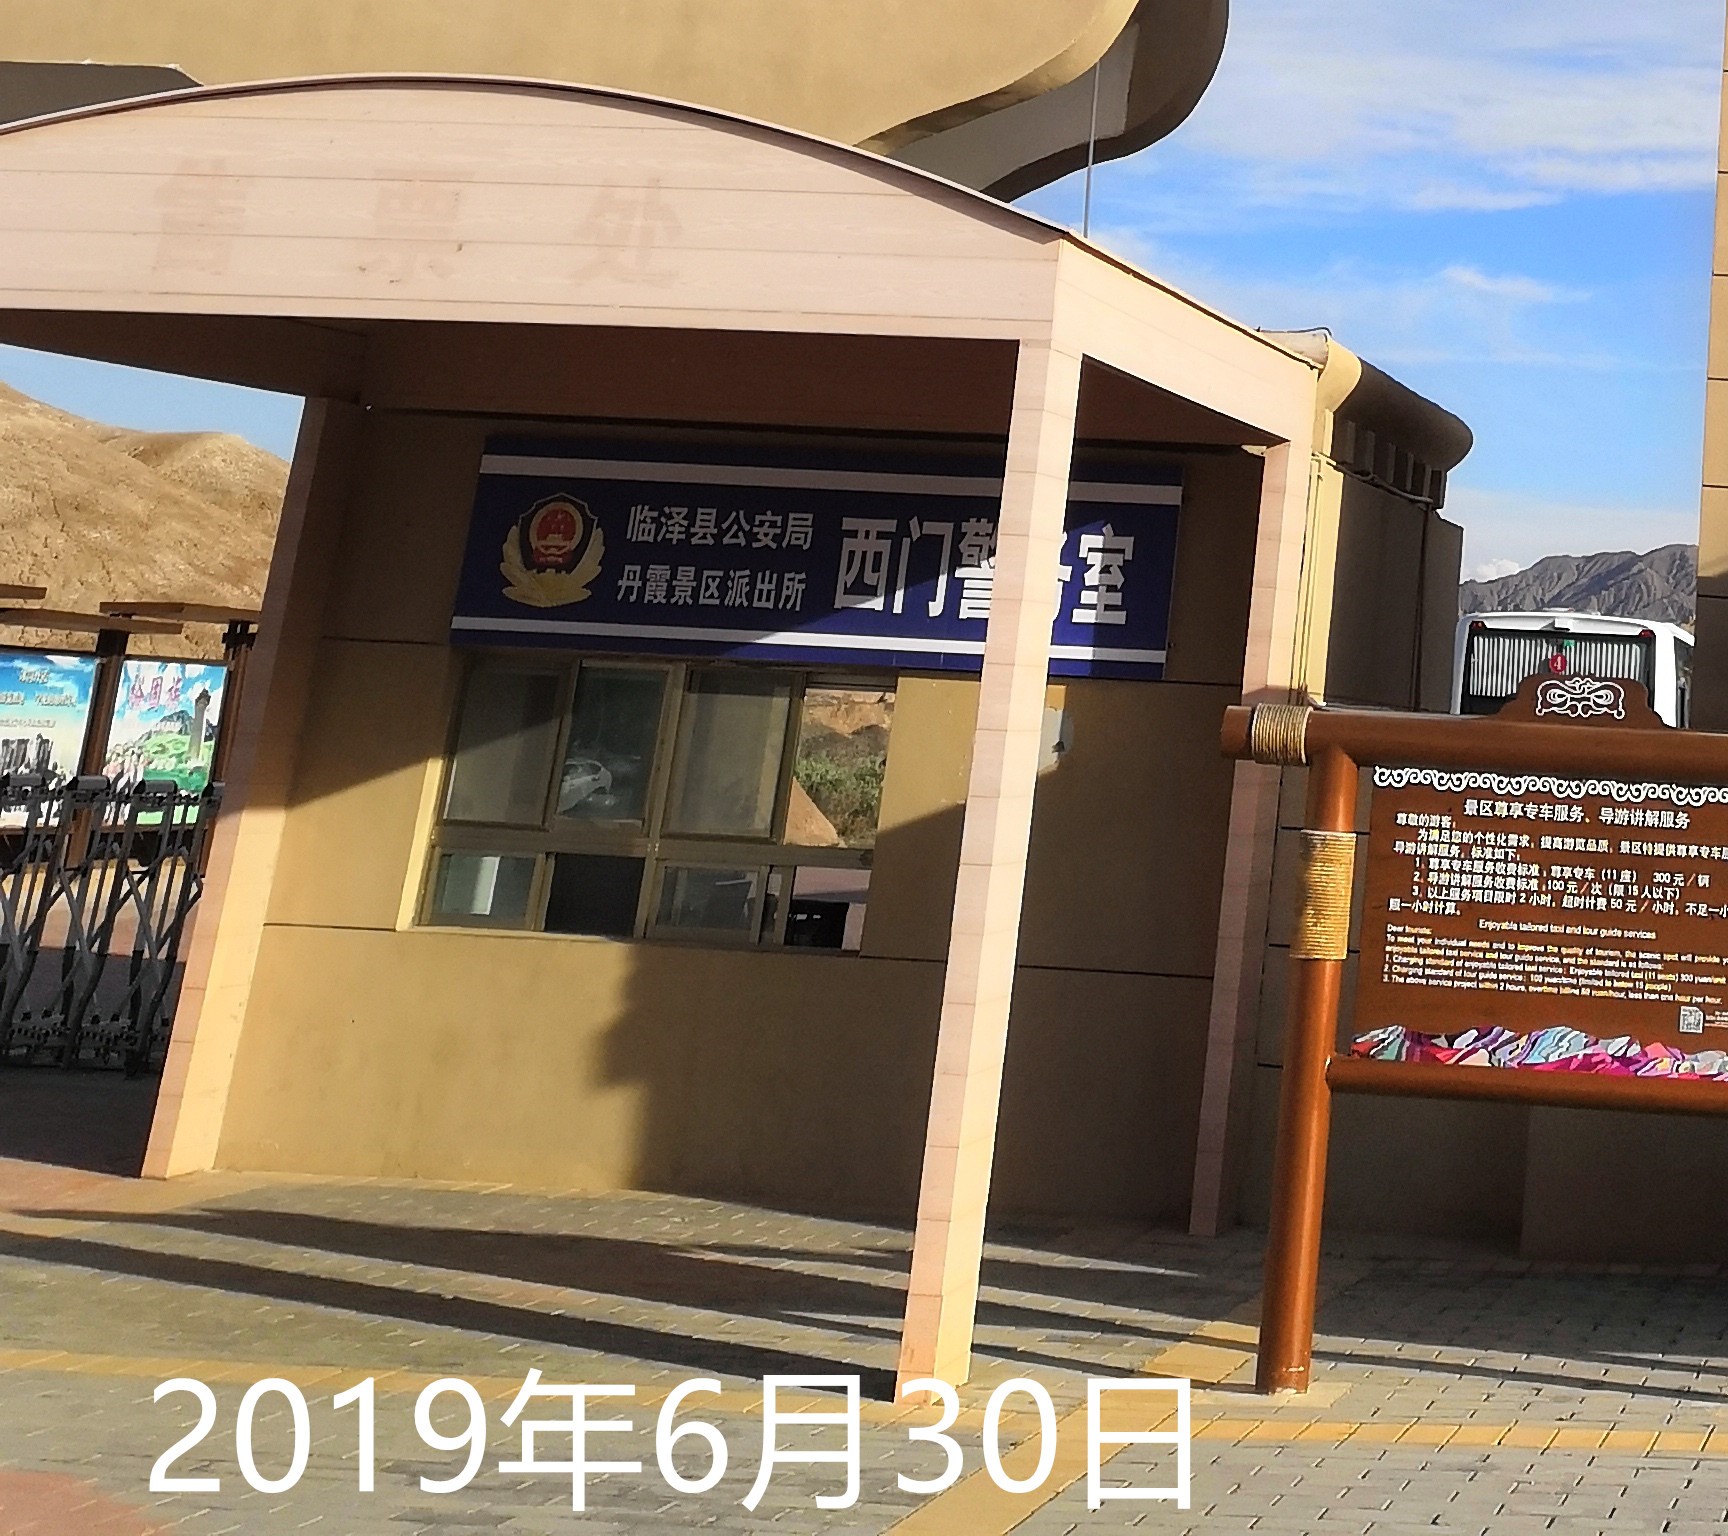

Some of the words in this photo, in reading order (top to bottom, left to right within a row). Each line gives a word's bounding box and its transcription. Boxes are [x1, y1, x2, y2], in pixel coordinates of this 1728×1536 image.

[626, 504, 815, 551] 临泽县公安局
[616, 563, 808, 612] 丹霞景区派出所
[834, 516, 1135, 626] 西门警室
